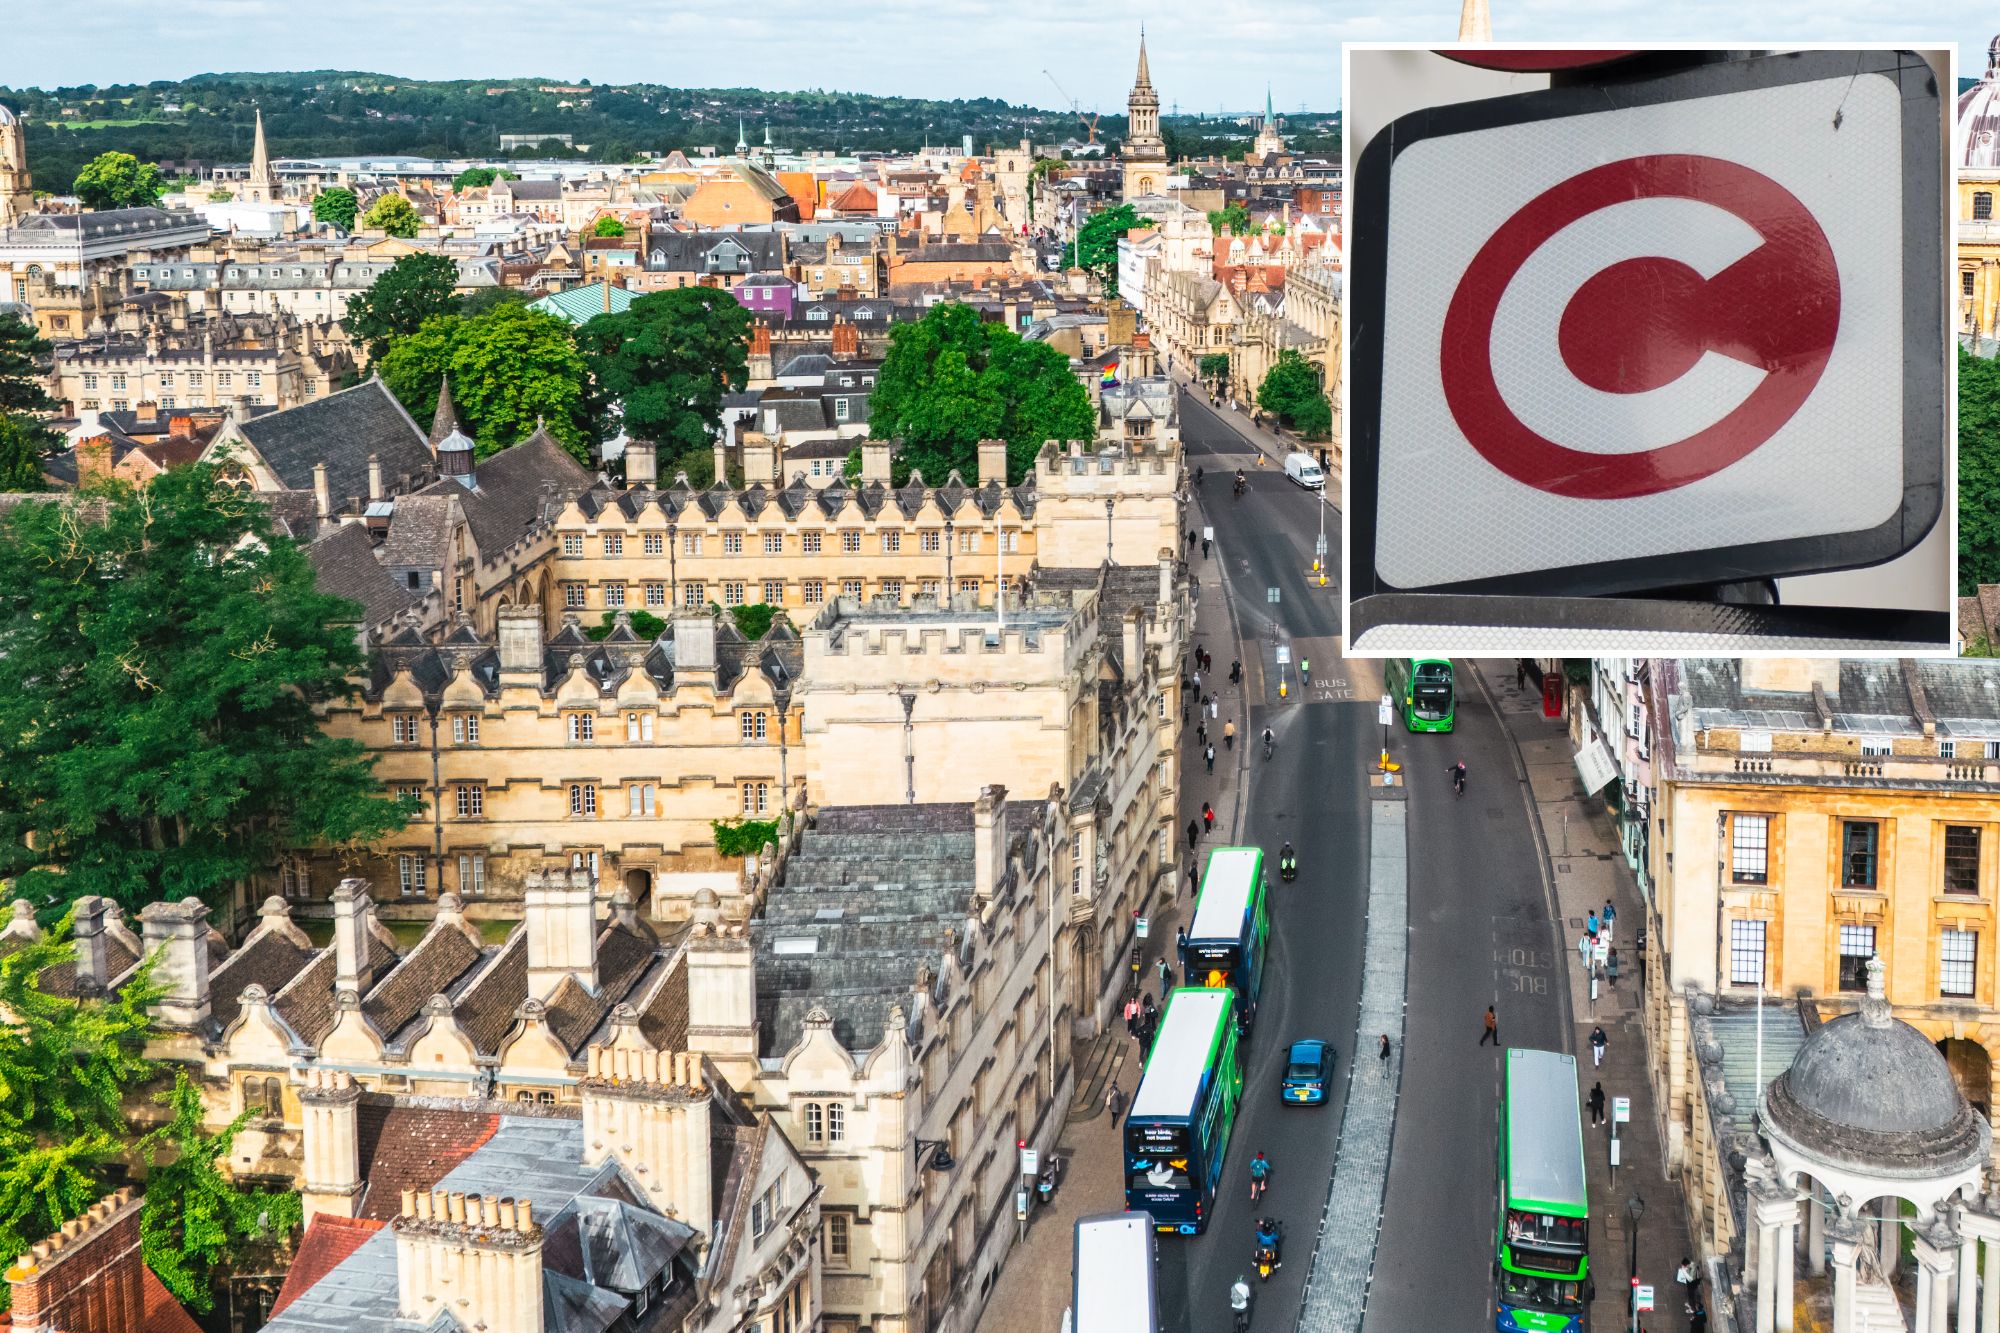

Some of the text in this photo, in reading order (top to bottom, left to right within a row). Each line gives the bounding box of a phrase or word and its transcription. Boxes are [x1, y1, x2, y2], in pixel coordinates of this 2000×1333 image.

[1489, 196, 1768, 455] C
[1314, 679, 1346, 688] BUS
[1312, 689, 1354, 699] GATE
[1499, 948, 1553, 969] STOP
[1510, 976, 1547, 995] BUS
